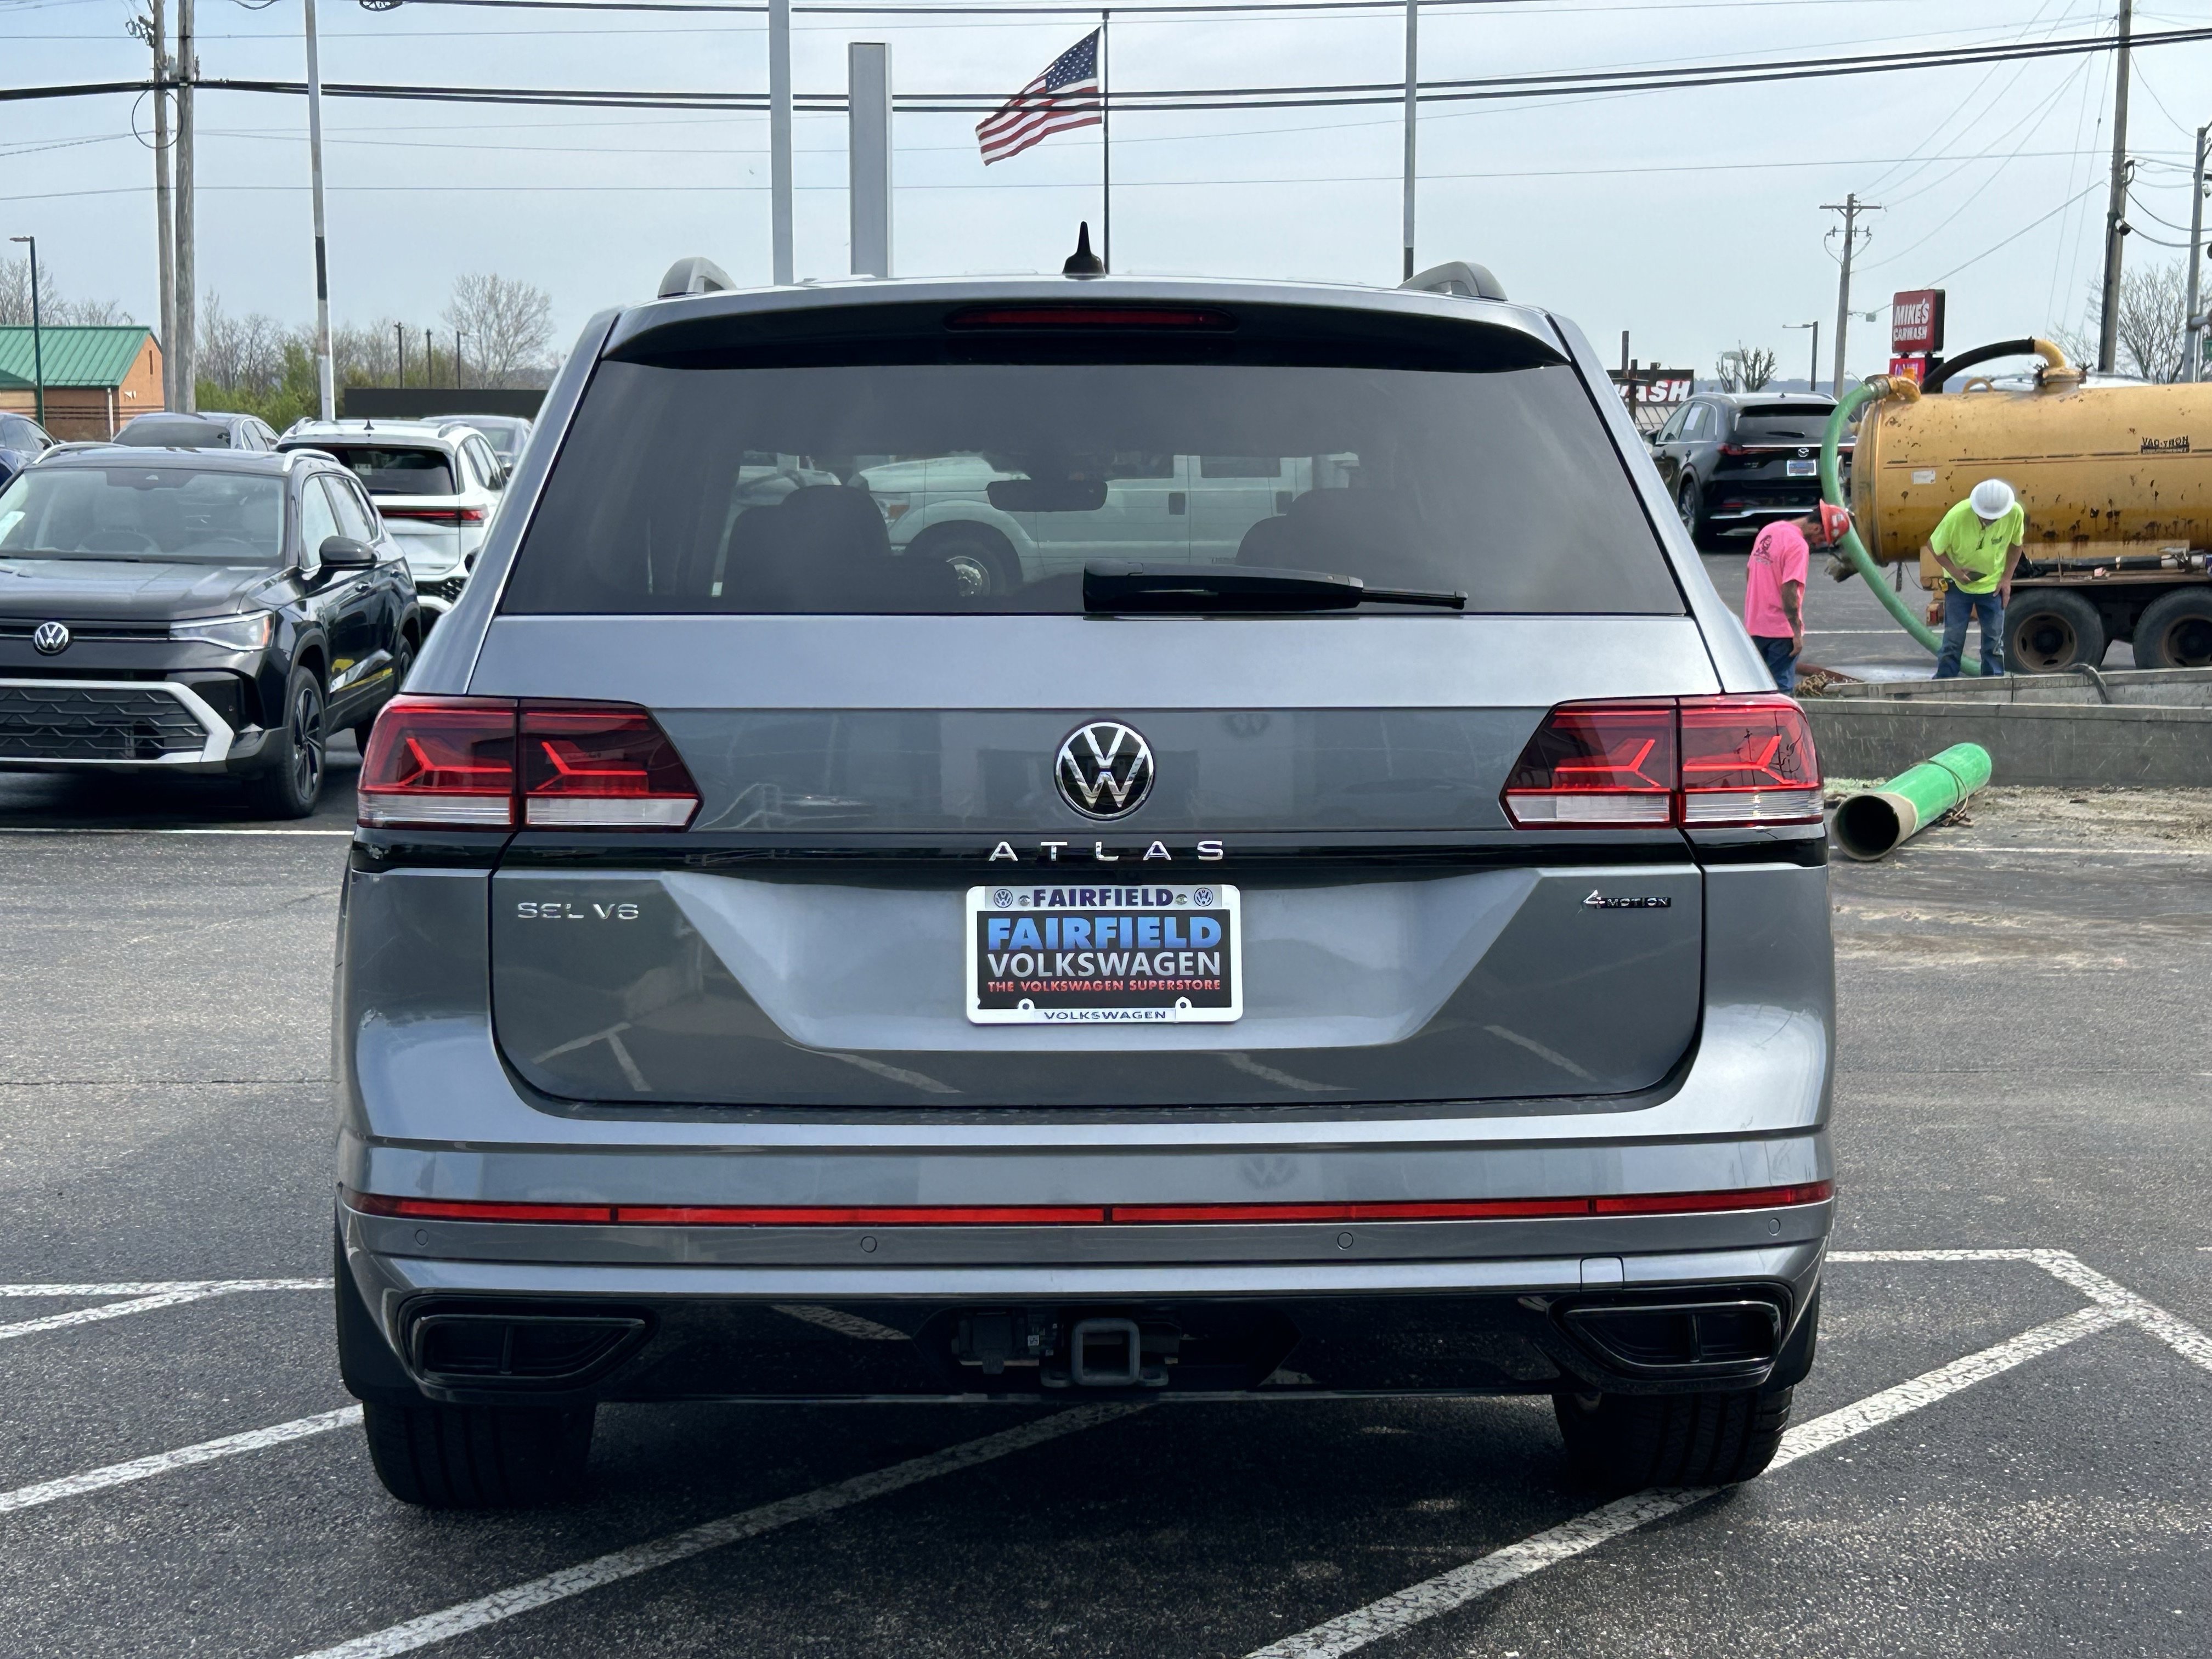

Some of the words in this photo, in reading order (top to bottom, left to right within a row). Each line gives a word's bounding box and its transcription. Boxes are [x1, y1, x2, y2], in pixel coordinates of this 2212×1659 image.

[1894, 298, 1929, 326] MIKE'S
[989, 840, 1223, 861] ATLAS
[1034, 889, 1173, 907] FAIRFIELD
[1583, 889, 1668, 909] 4MOTION
[517, 902, 584, 919] SEL
[593, 903, 639, 920] V6
[988, 917, 1222, 950] FAIRFIELD
[988, 951, 1221, 977] VOLKSWAGEN
[988, 981, 1014, 992] THE
[1020, 980, 1124, 992] VOLKSWAGEN
[1129, 979, 1221, 991] SUPERSTORE
[1044, 1011, 1166, 1020] VOLKSWAGEN
